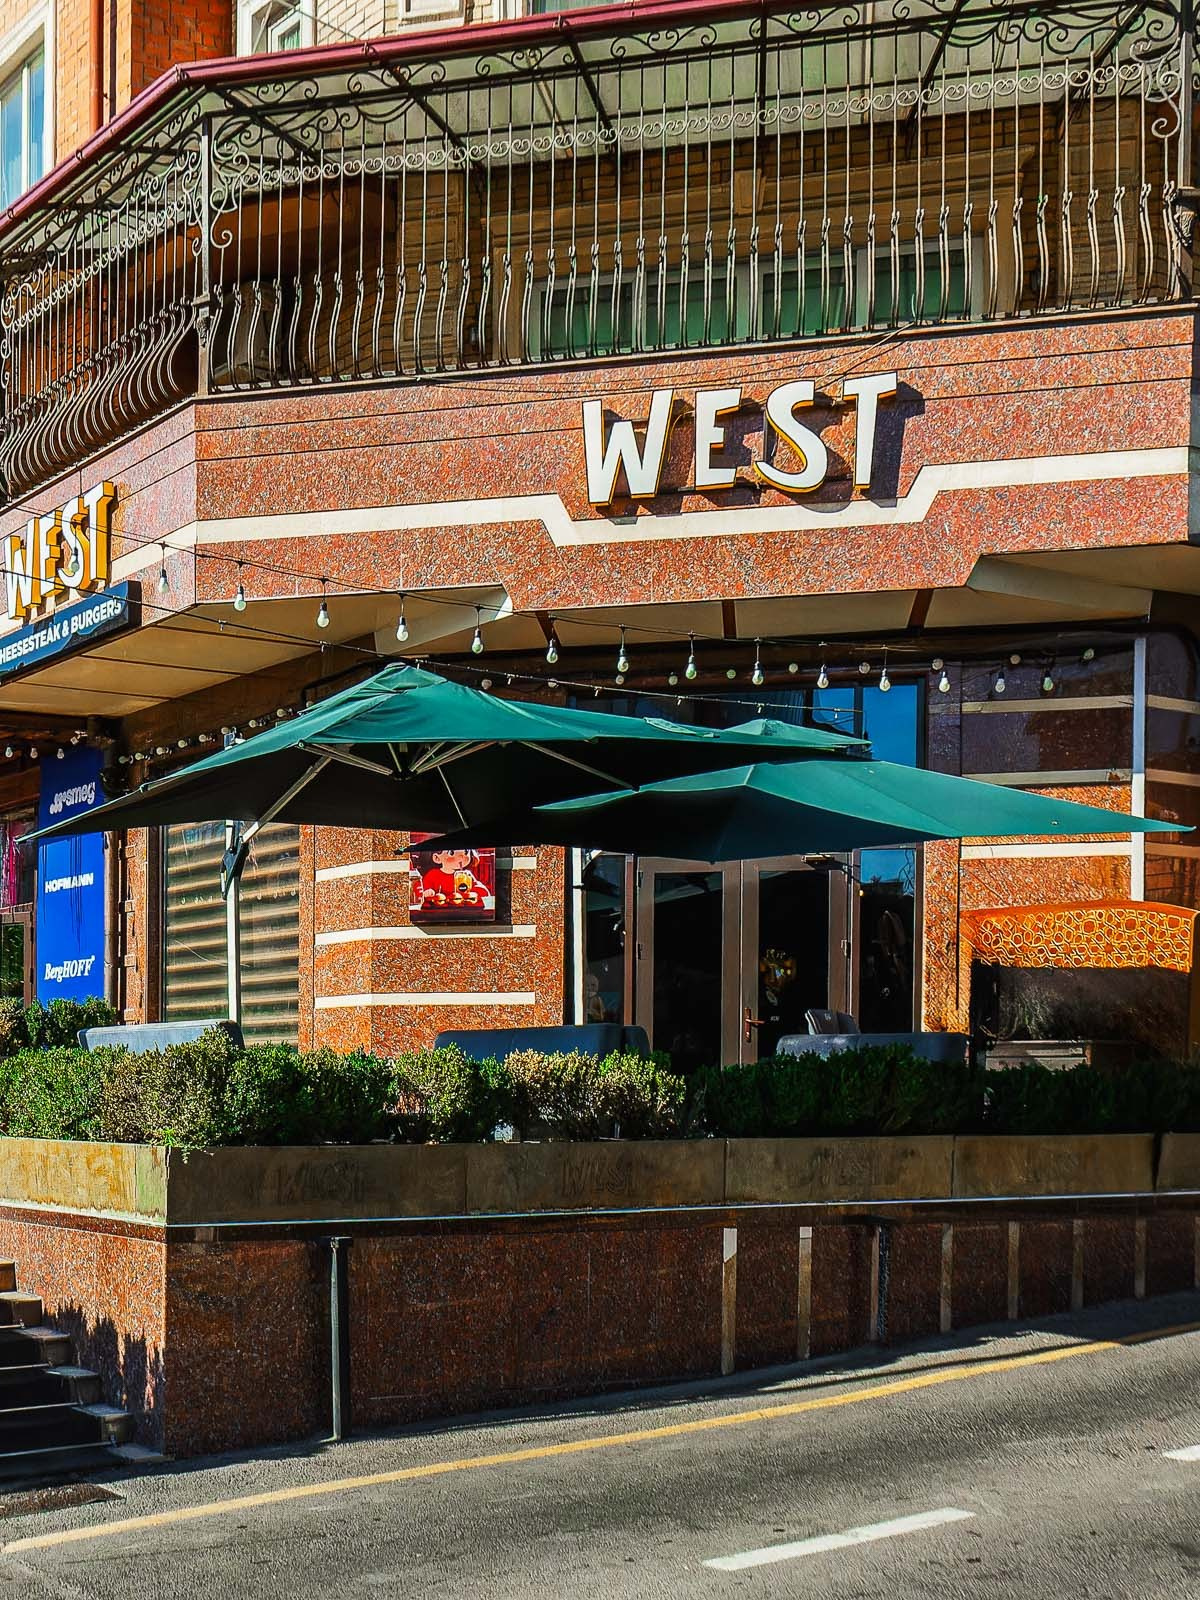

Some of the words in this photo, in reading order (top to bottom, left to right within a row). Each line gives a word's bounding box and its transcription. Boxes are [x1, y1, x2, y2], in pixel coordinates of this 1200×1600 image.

[583, 372, 897, 505] WEST
[4, 481, 113, 619] WEST
[62, 620, 69, 637] &
[70, 599, 122, 633] BURGERS
[45, 872, 94, 893] HOFMANN
[44, 957, 94, 982] BergHOFF
